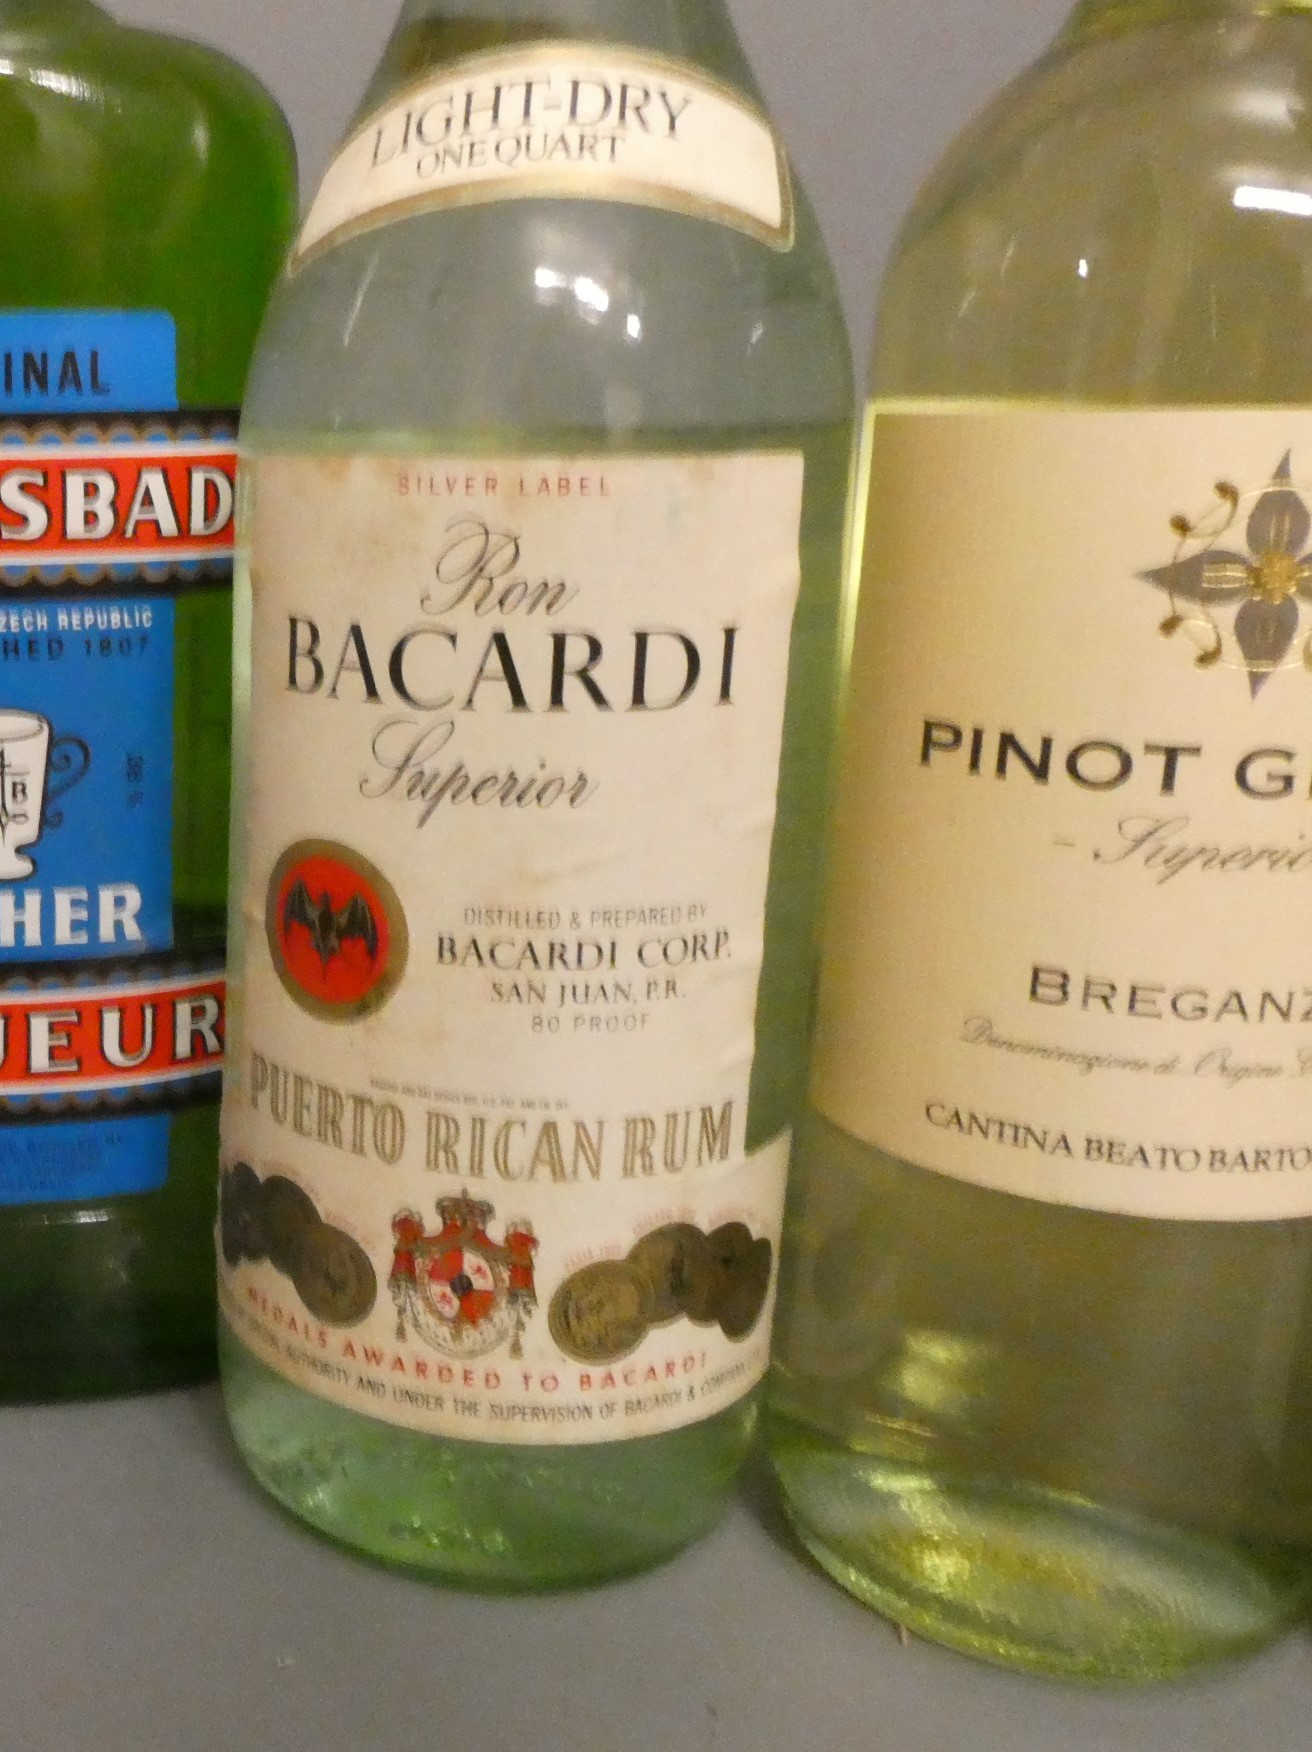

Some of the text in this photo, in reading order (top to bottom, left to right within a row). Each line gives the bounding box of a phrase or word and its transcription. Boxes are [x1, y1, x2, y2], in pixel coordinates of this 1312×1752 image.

[366, 72, 692, 170] LIGHT-DRY
[415, 131, 627, 180] ONE QUART
[397, 473, 613, 498] SILVER LABEL
[419, 513, 581, 619] Ron
[57, 604, 154, 631] REPUBLIC
[83, 634, 150, 659] 1807
[285, 614, 741, 714] BACARDI
[359, 718, 599, 831] Superior
[919, 718, 1312, 801] PINOT G
[464, 903, 709, 931] DISTILLED & PREPARED BY
[437, 926, 733, 972] BACARDI CORP.
[490, 981, 548, 1005] SAN
[530, 1012, 651, 1035] 80 PROOF
[249, 1051, 736, 1184] PUERTO RICAN RUM
[924, 1100, 1074, 1158] CANTINA
[1085, 1136, 1202, 1173] BEATO
[340, 1338, 502, 1390] AWARDED
[520, 1370, 560, 1393] TO
[578, 1350, 708, 1393] BACARDI
[355, 1374, 388, 1398] AND
[391, 1386, 445, 1413] UNDER
[452, 1397, 482, 1419] THE
[488, 1401, 594, 1422] SUPERVISION
[598, 1401, 617, 1420] OF
